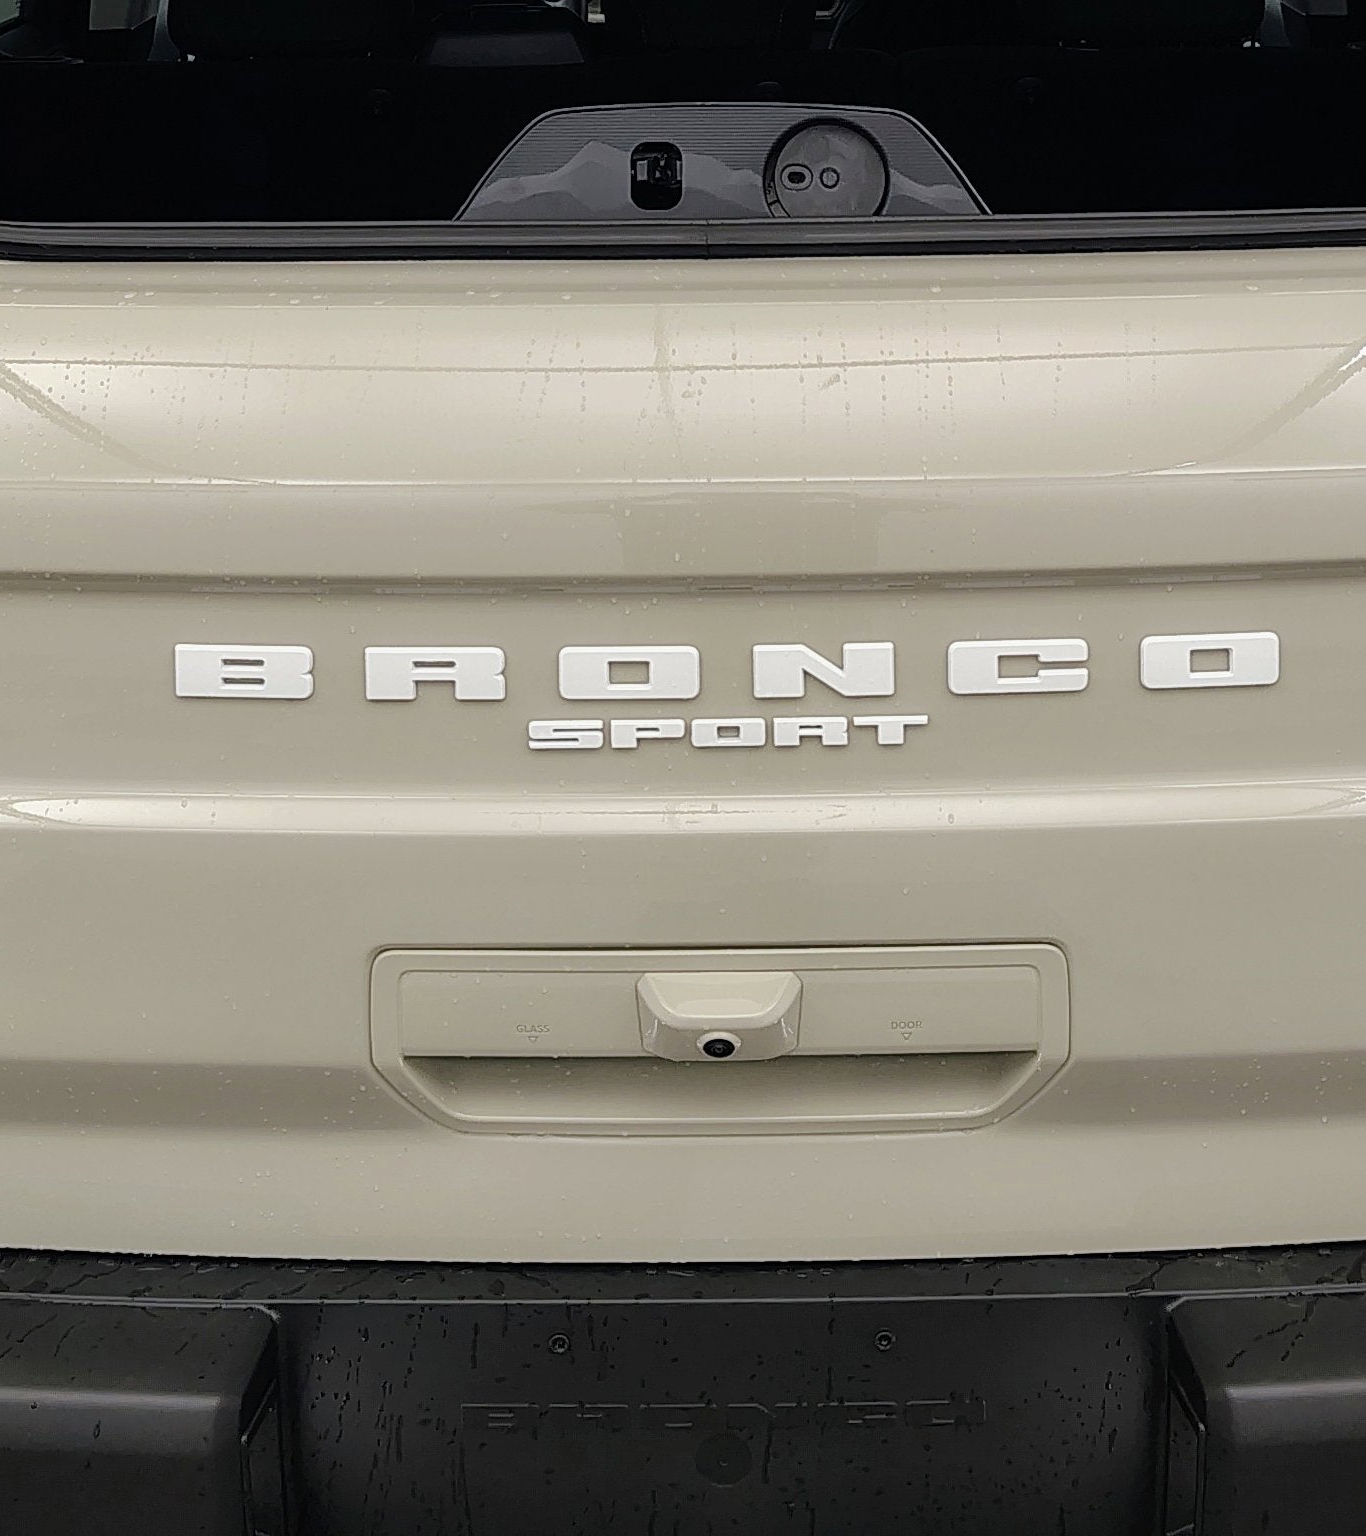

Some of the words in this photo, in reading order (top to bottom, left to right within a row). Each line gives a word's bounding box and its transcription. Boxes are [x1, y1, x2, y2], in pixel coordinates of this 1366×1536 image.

[173, 630, 1281, 700] BRONCO
[527, 714, 929, 749] SPORT
[515, 1023, 551, 1034] GLASS
[890, 1020, 923, 1030] DOOR
